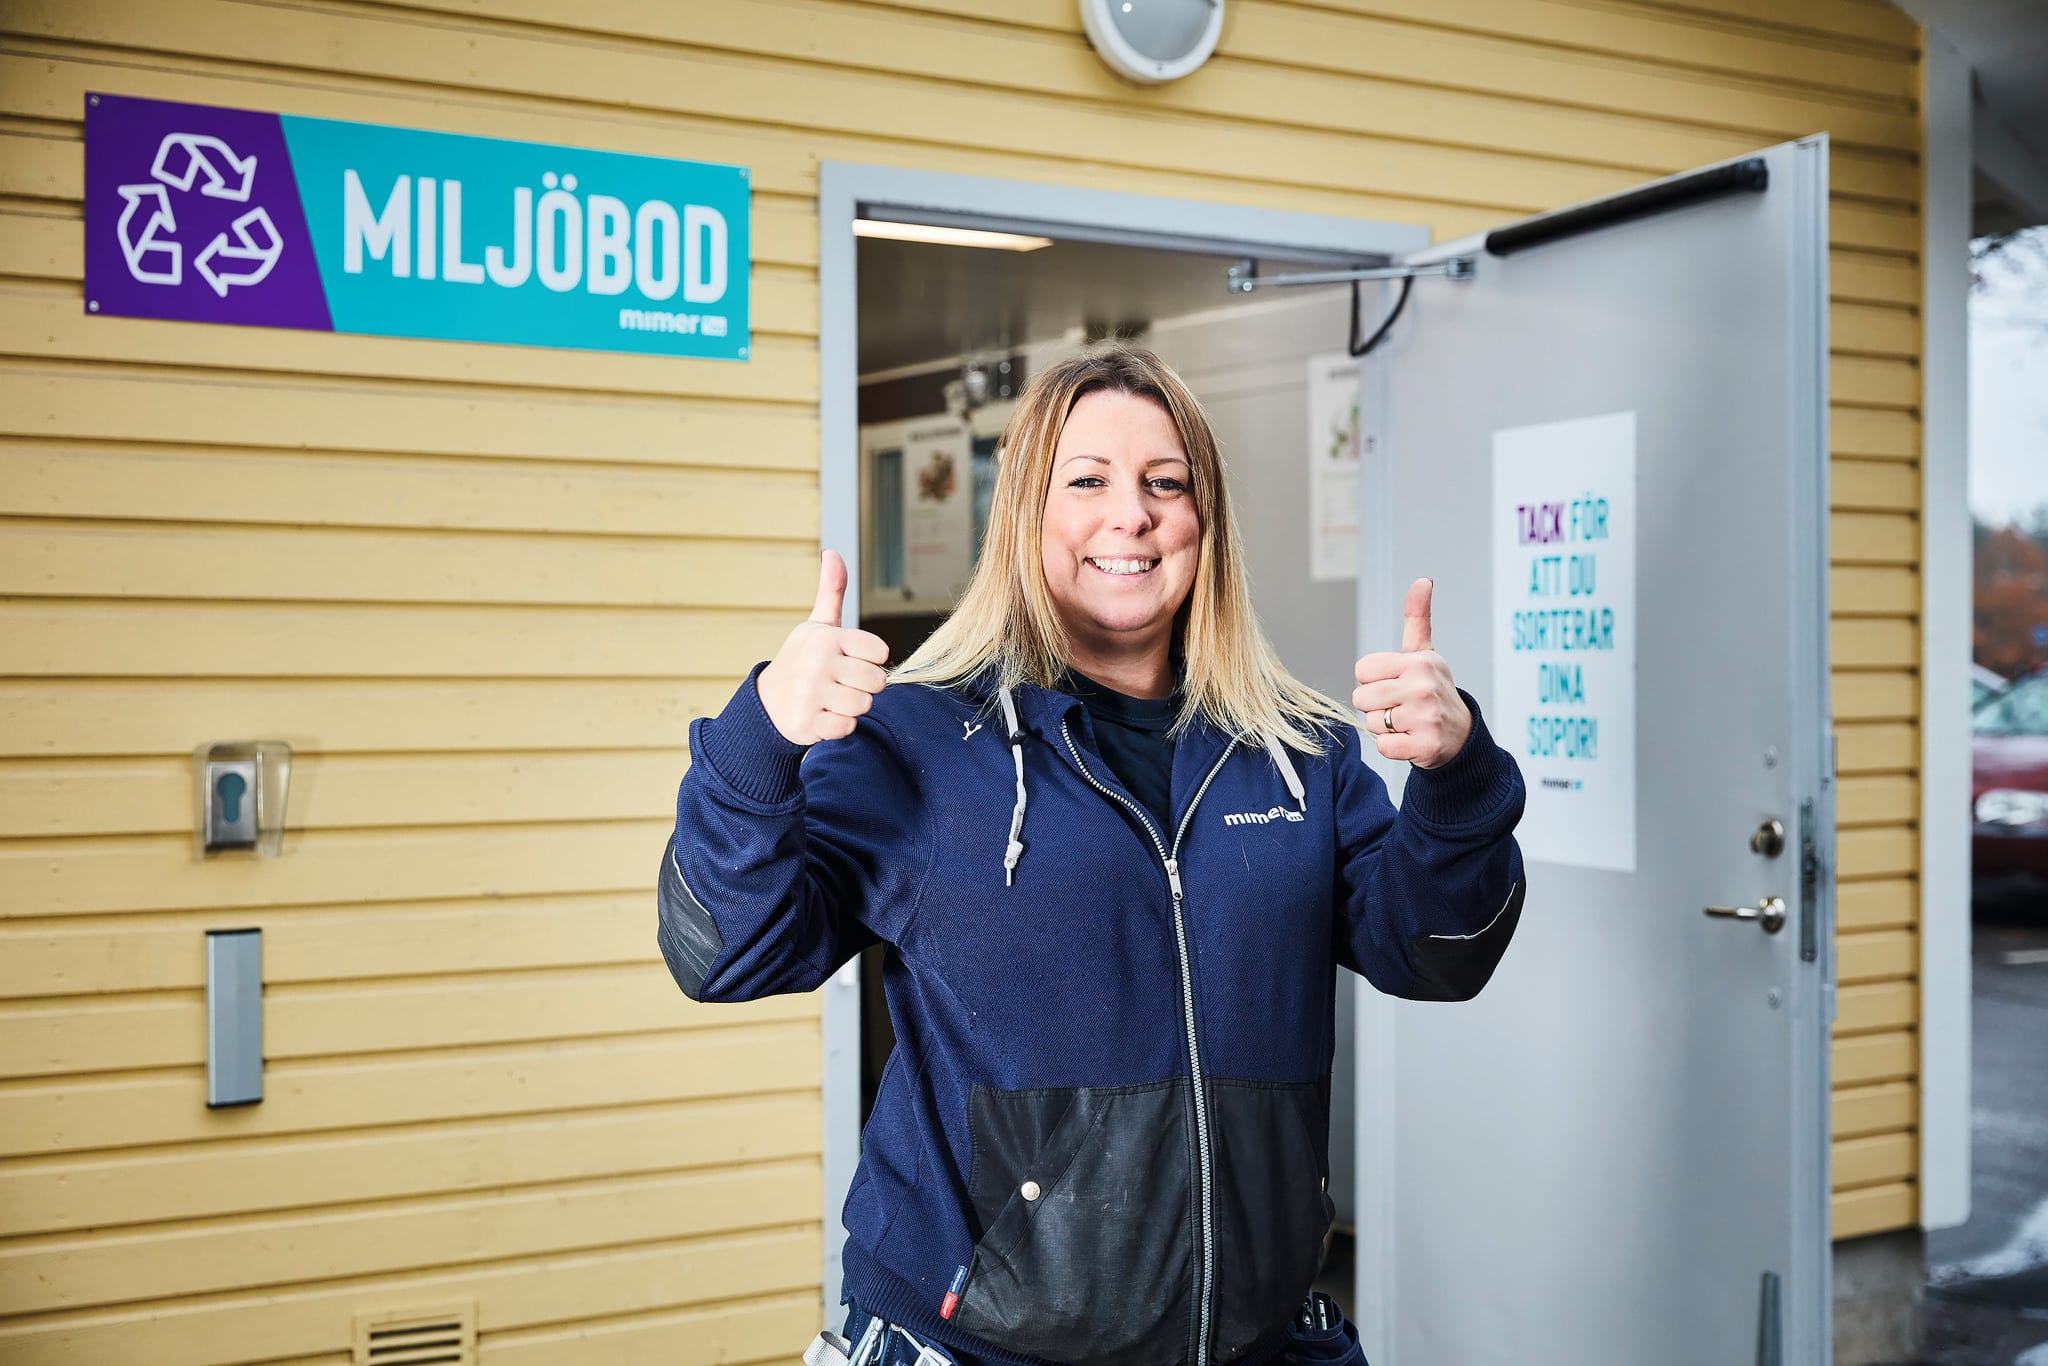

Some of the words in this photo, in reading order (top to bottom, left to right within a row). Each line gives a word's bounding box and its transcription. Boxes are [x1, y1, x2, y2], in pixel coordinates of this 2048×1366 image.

[343, 169, 729, 304] MILJÖBOD
[619, 308, 700, 335] mimer
[1516, 502, 1565, 546] TACK
[1570, 490, 1610, 541] FÖR
[1528, 555, 1562, 597] ATT
[1568, 553, 1597, 597] DU
[1512, 606, 1616, 651] SORTERAR
[1538, 662, 1586, 705] DINA
[1527, 715, 1599, 760] SOPOR!
